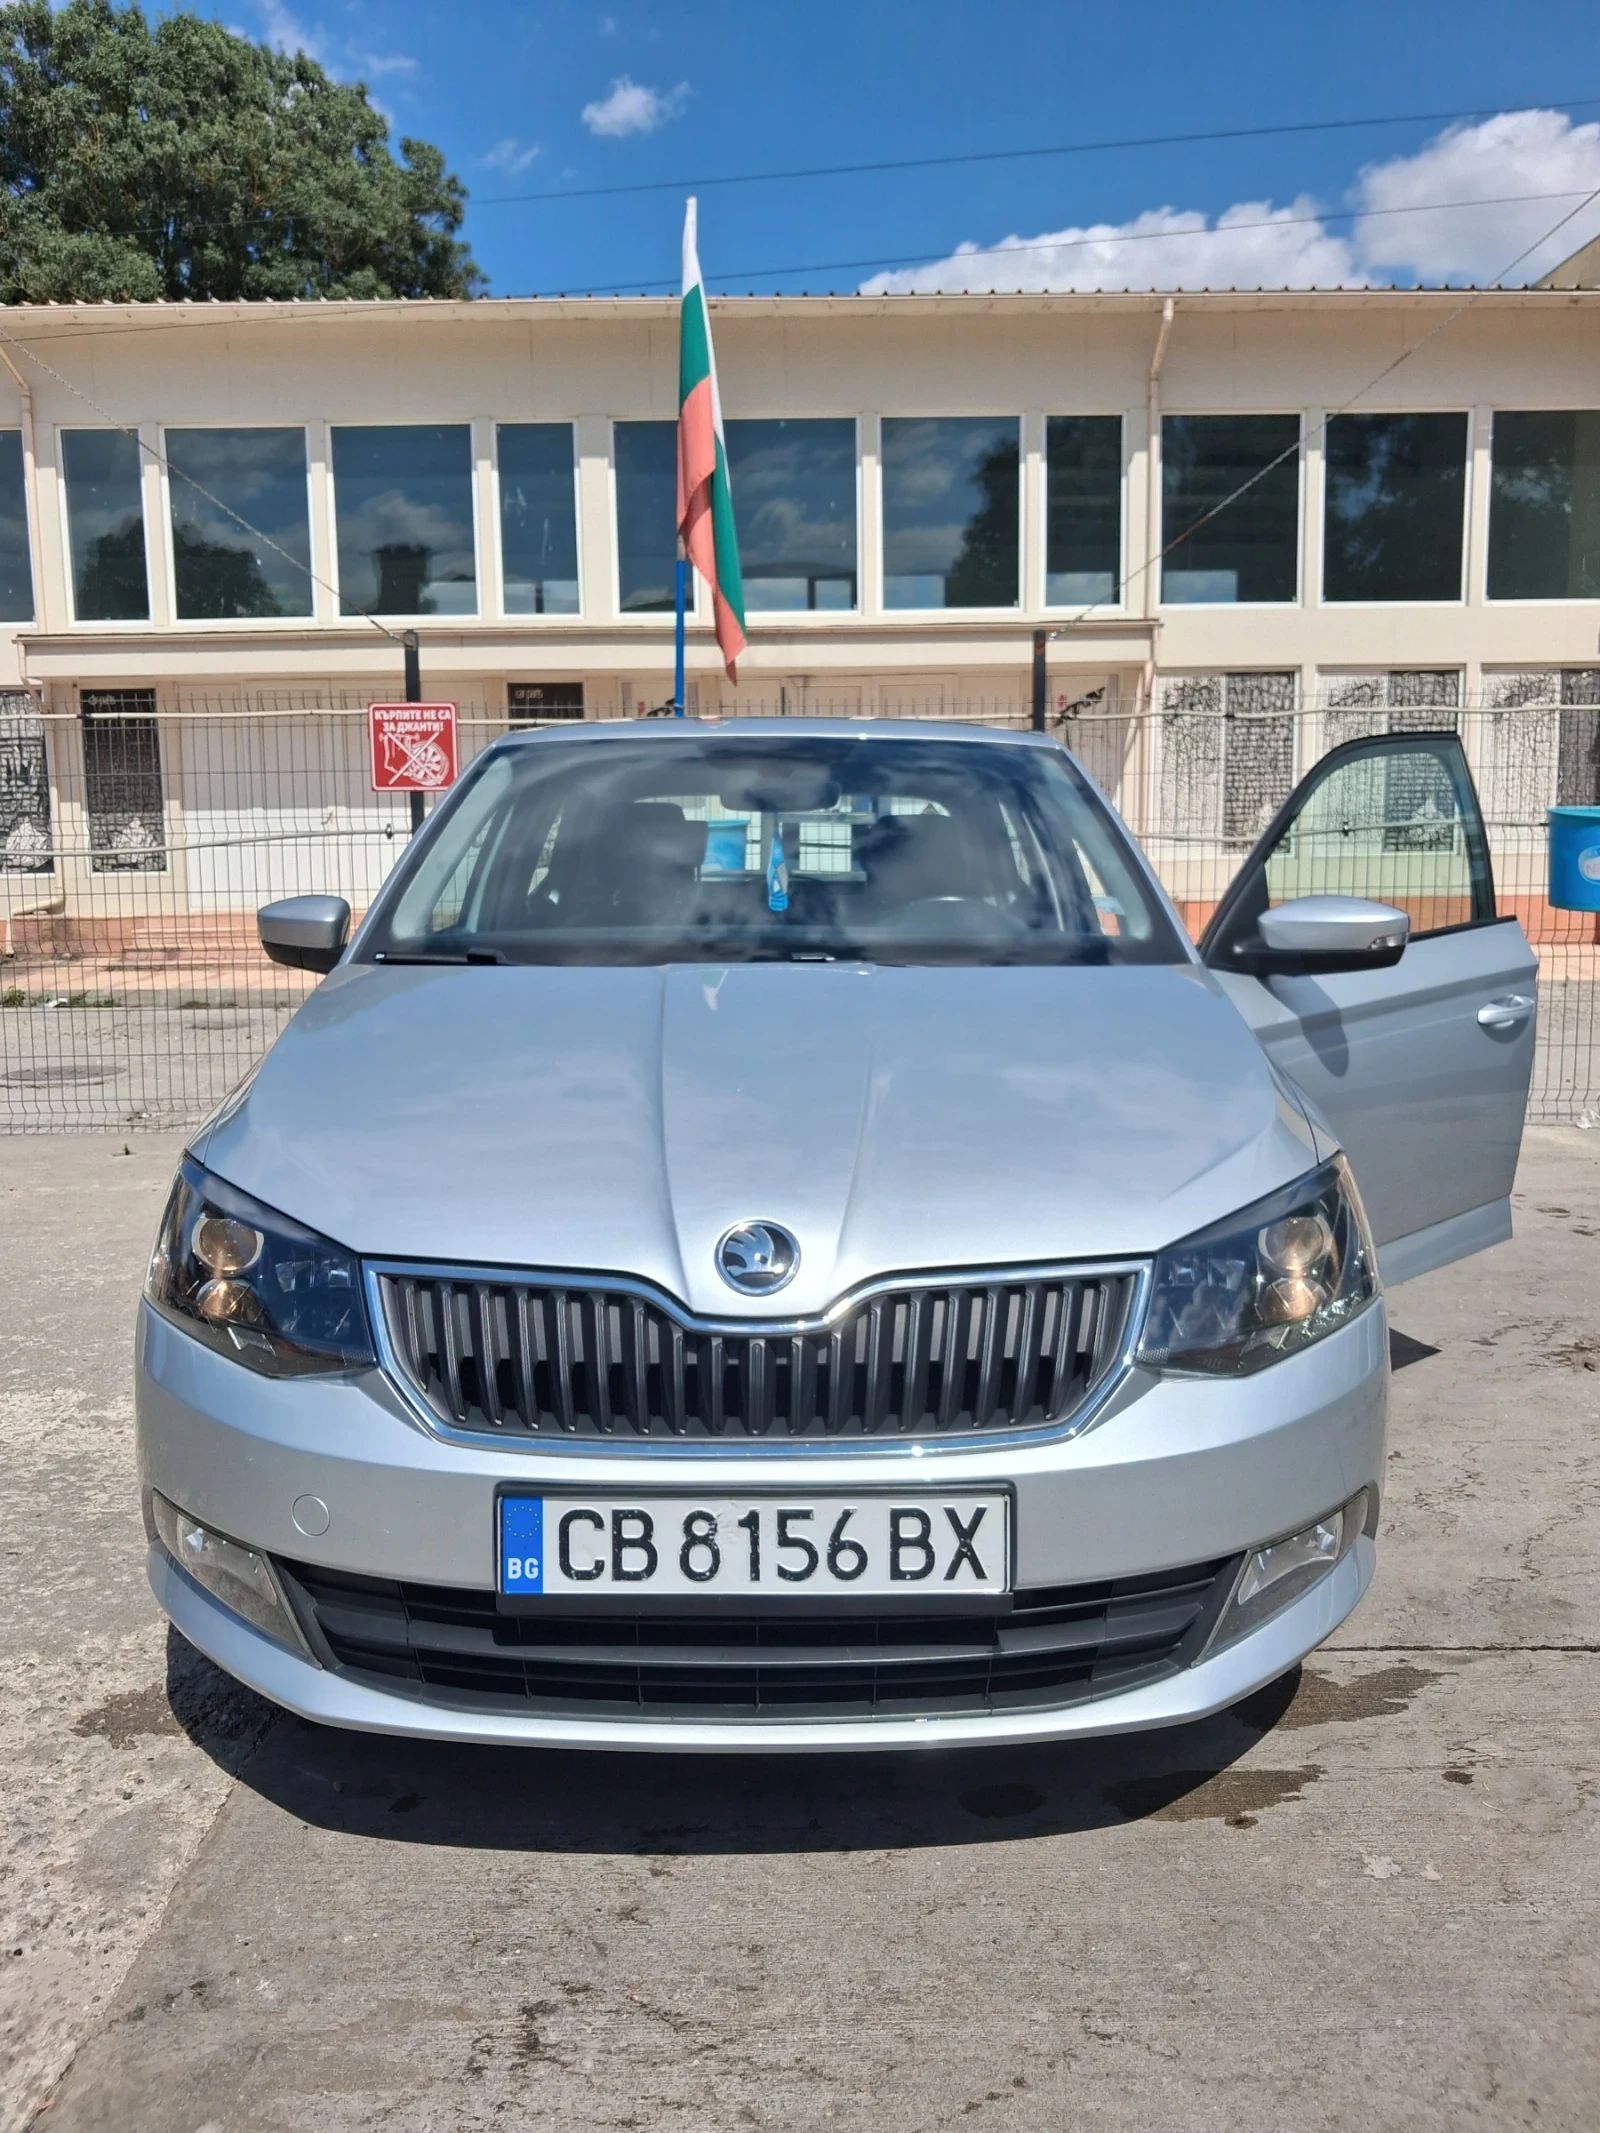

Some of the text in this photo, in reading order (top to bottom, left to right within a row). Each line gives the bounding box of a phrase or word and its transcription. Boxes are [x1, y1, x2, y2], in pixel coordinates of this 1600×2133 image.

[374, 708, 452, 720] КЪРПИТЕ НЕ СА
[382, 721, 444, 733] ЗА ДЖАНТИ!
[558, 1507, 988, 1582] CB 8156 BX
[507, 1557, 539, 1579] BG
